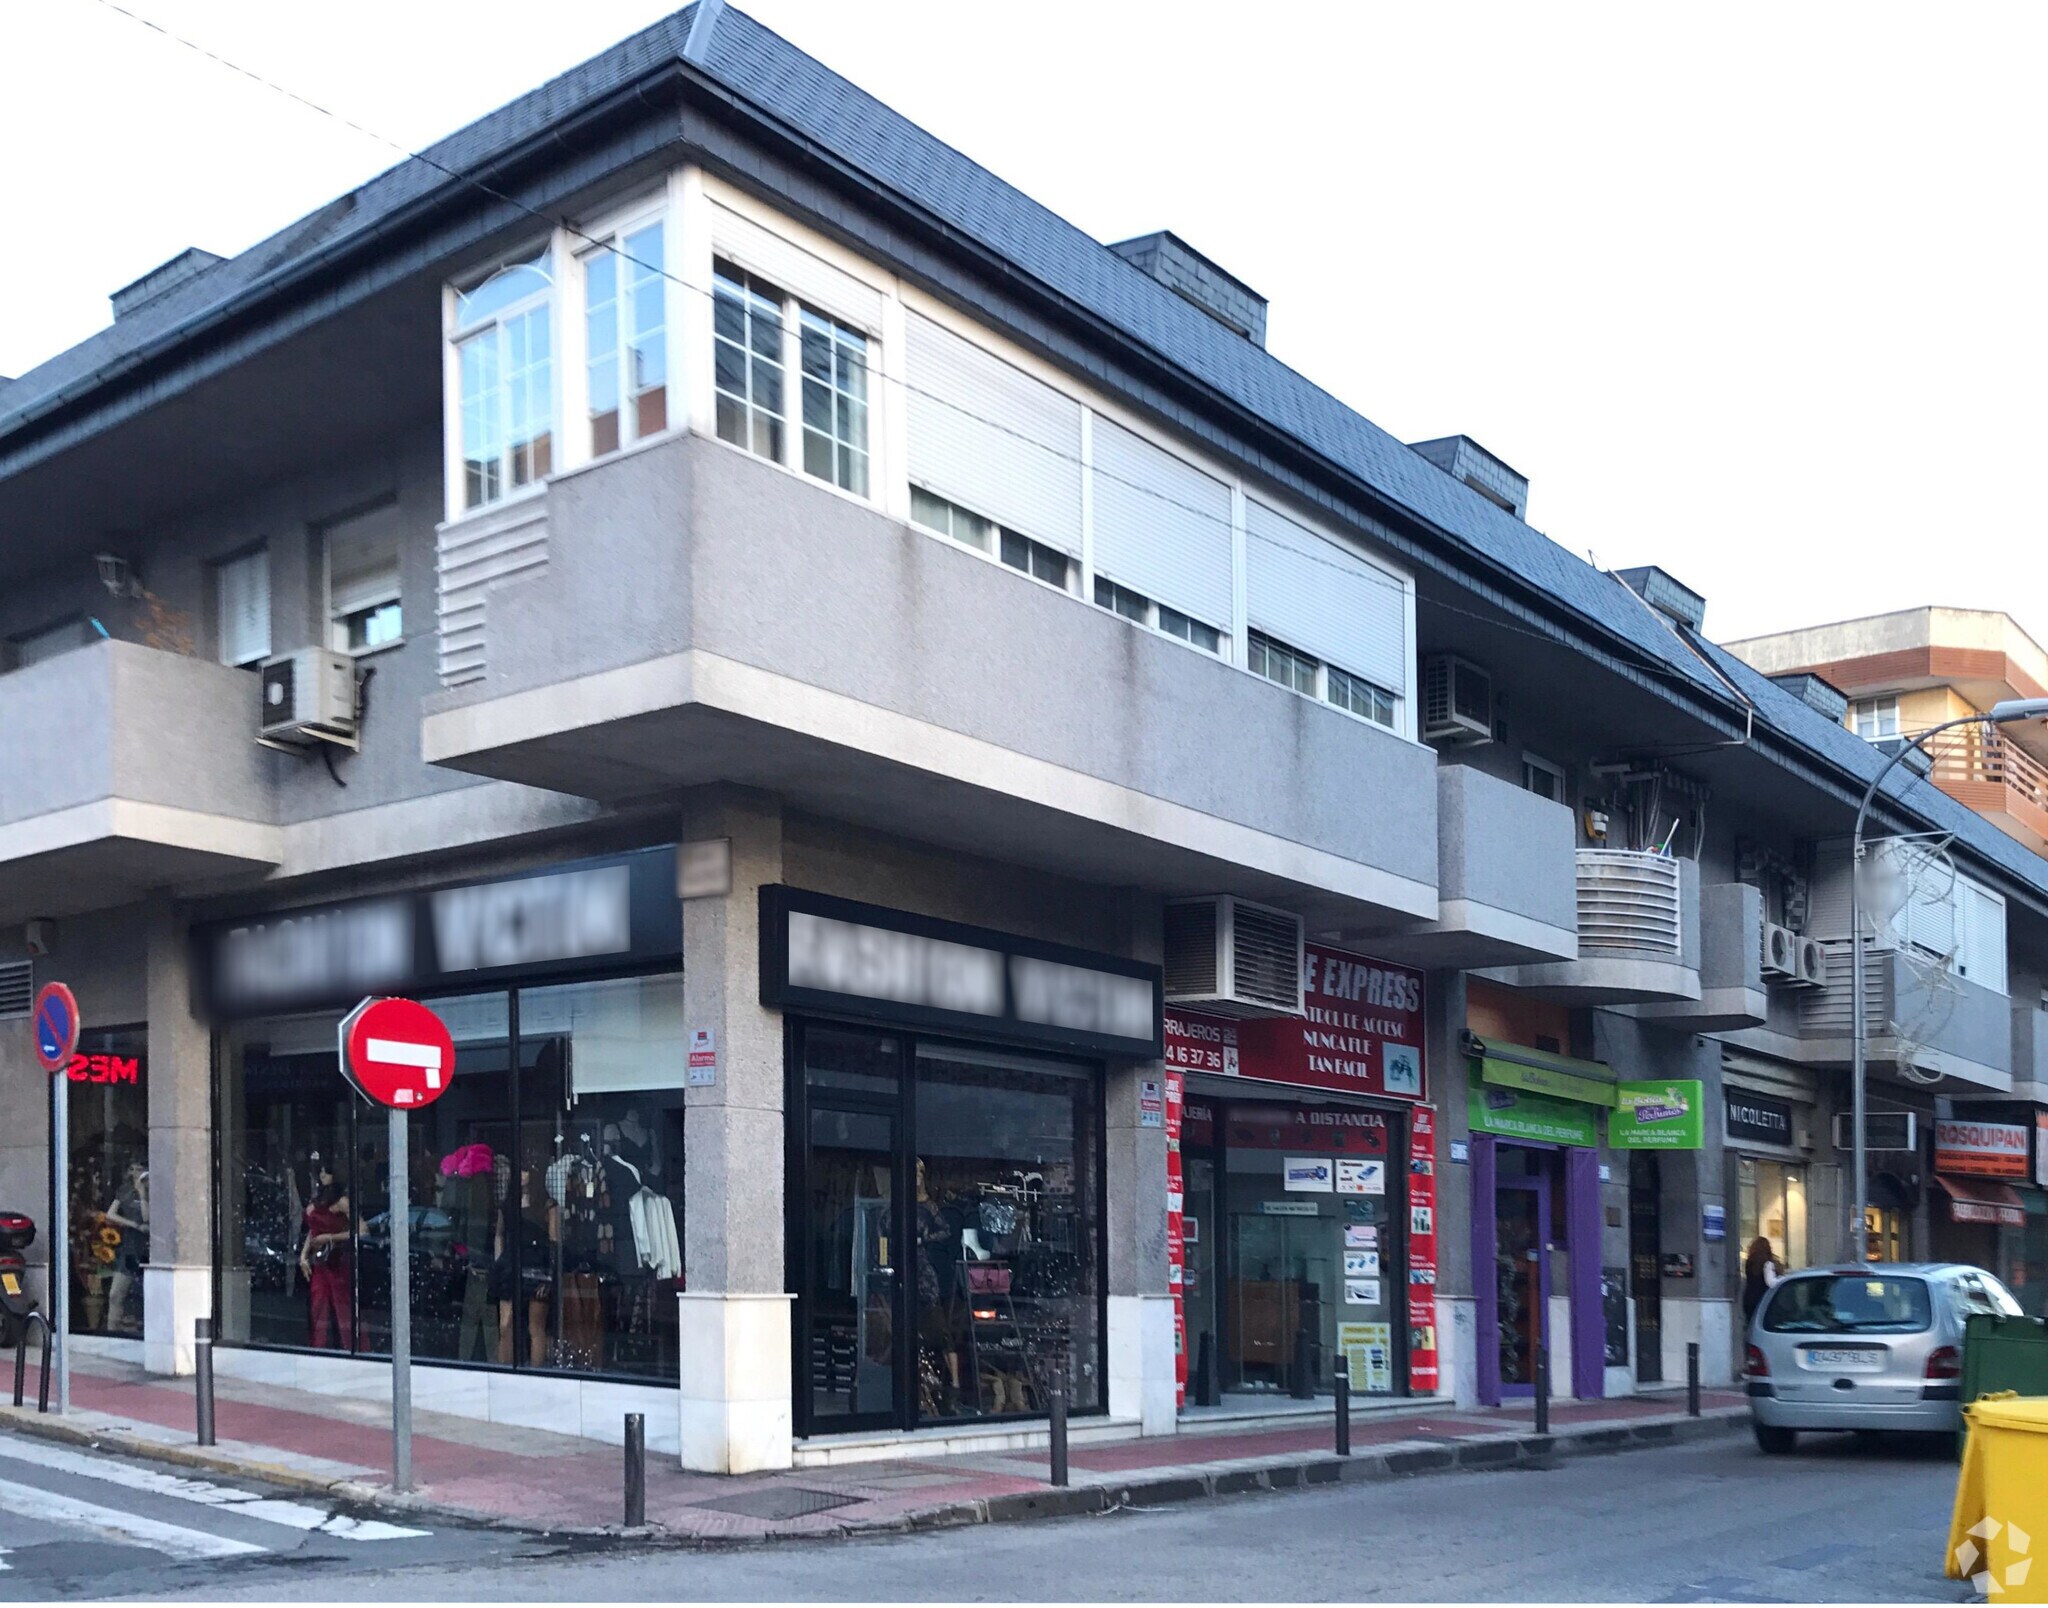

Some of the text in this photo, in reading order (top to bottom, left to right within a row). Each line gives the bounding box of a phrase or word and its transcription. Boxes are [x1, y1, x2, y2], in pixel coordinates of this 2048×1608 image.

[1323, 957, 1420, 1012] EXPRESS
[1343, 1012, 1360, 1031] DE
[1363, 1016, 1406, 1039] ACCESO
[1303, 1029, 1372, 1056] NUNCA FUE
[1176, 1046, 1188, 1063] 16
[1190, 1048, 1204, 1065] 37
[1207, 1051, 1221, 1068] 36
[1307, 1054, 1333, 1074] TAN
[1295, 1111, 1306, 1124] A
[1310, 1112, 1385, 1128] DISTANCIA
[1730, 1104, 1787, 1131] NICOLETTA
[1937, 1123, 2025, 1149] ROSQUIPAN
